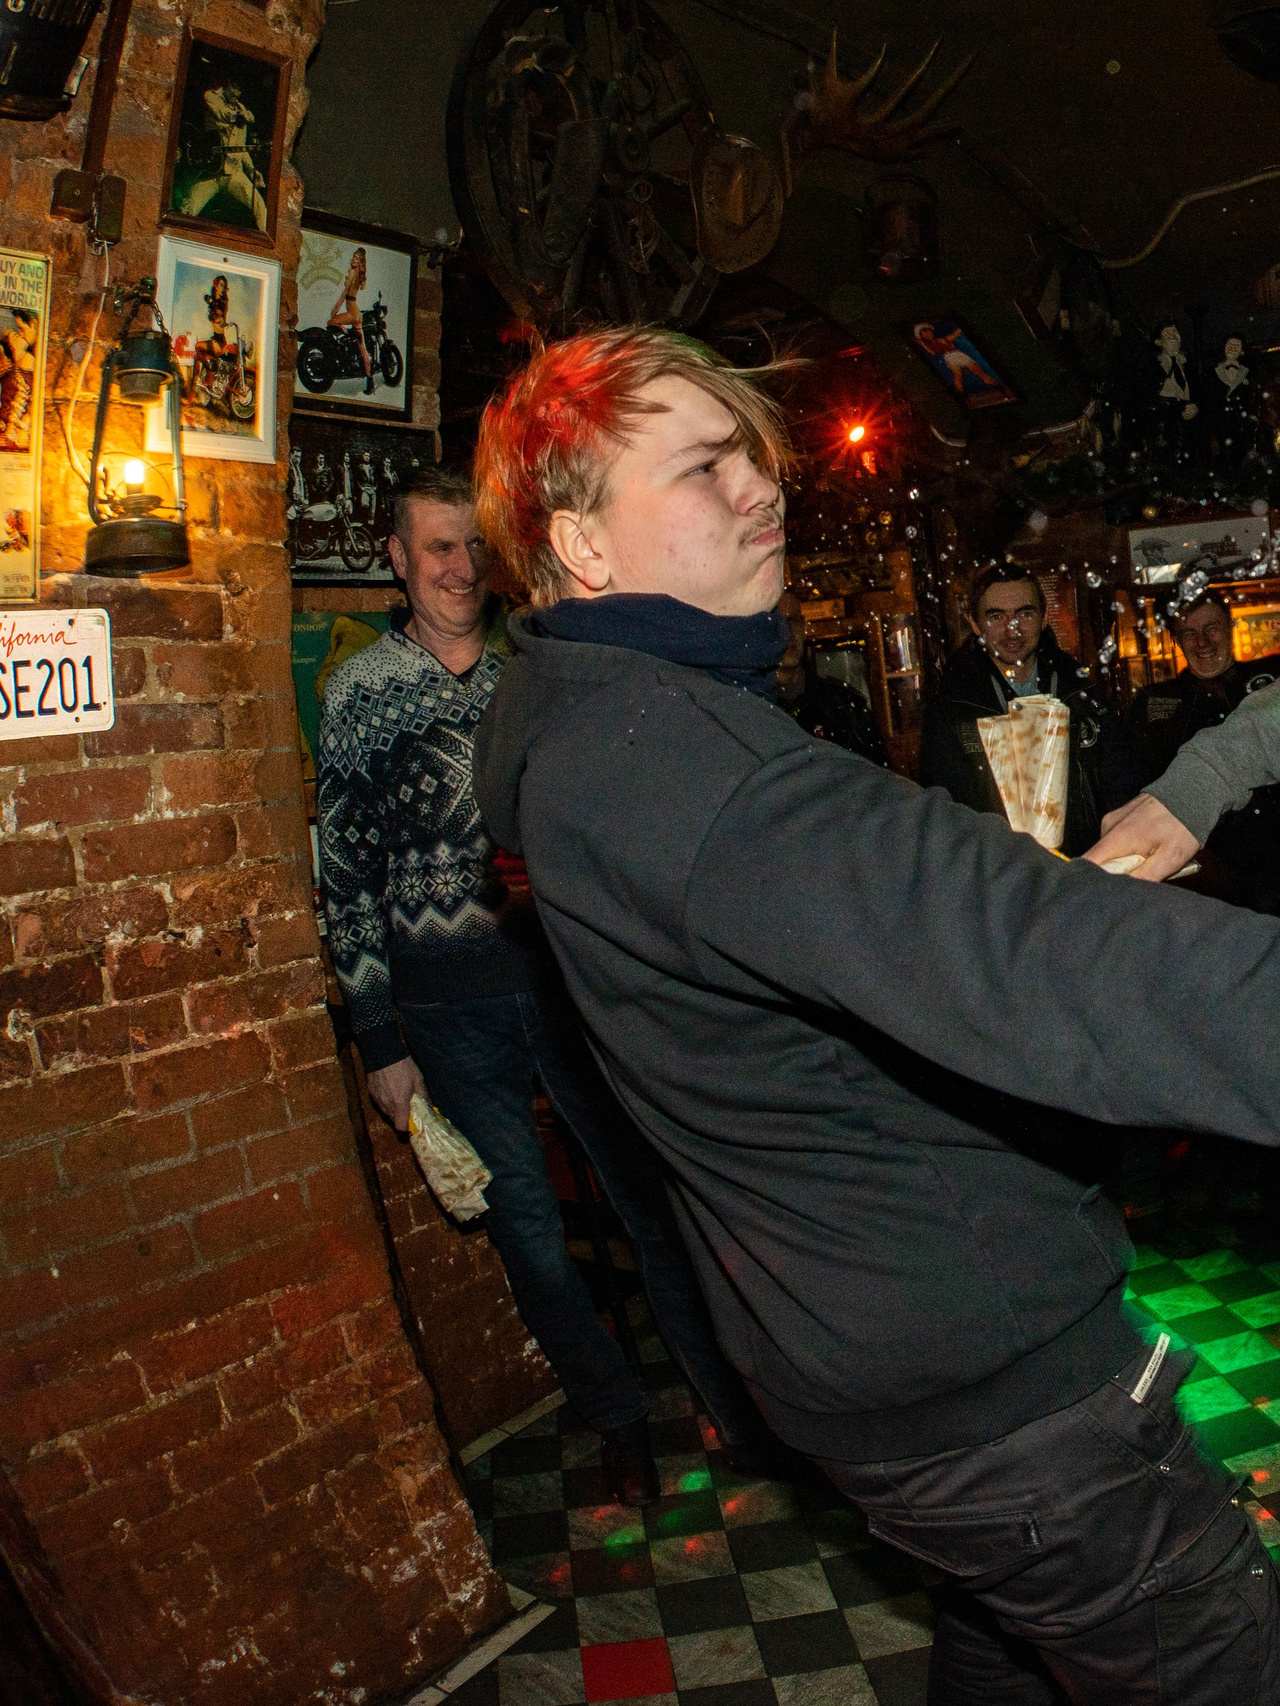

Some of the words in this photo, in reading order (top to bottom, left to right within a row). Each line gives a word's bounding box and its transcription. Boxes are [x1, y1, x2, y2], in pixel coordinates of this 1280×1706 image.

[18, 263, 44, 279] AND
[4, 276, 17, 290] IN
[20, 277, 43, 294] THE
